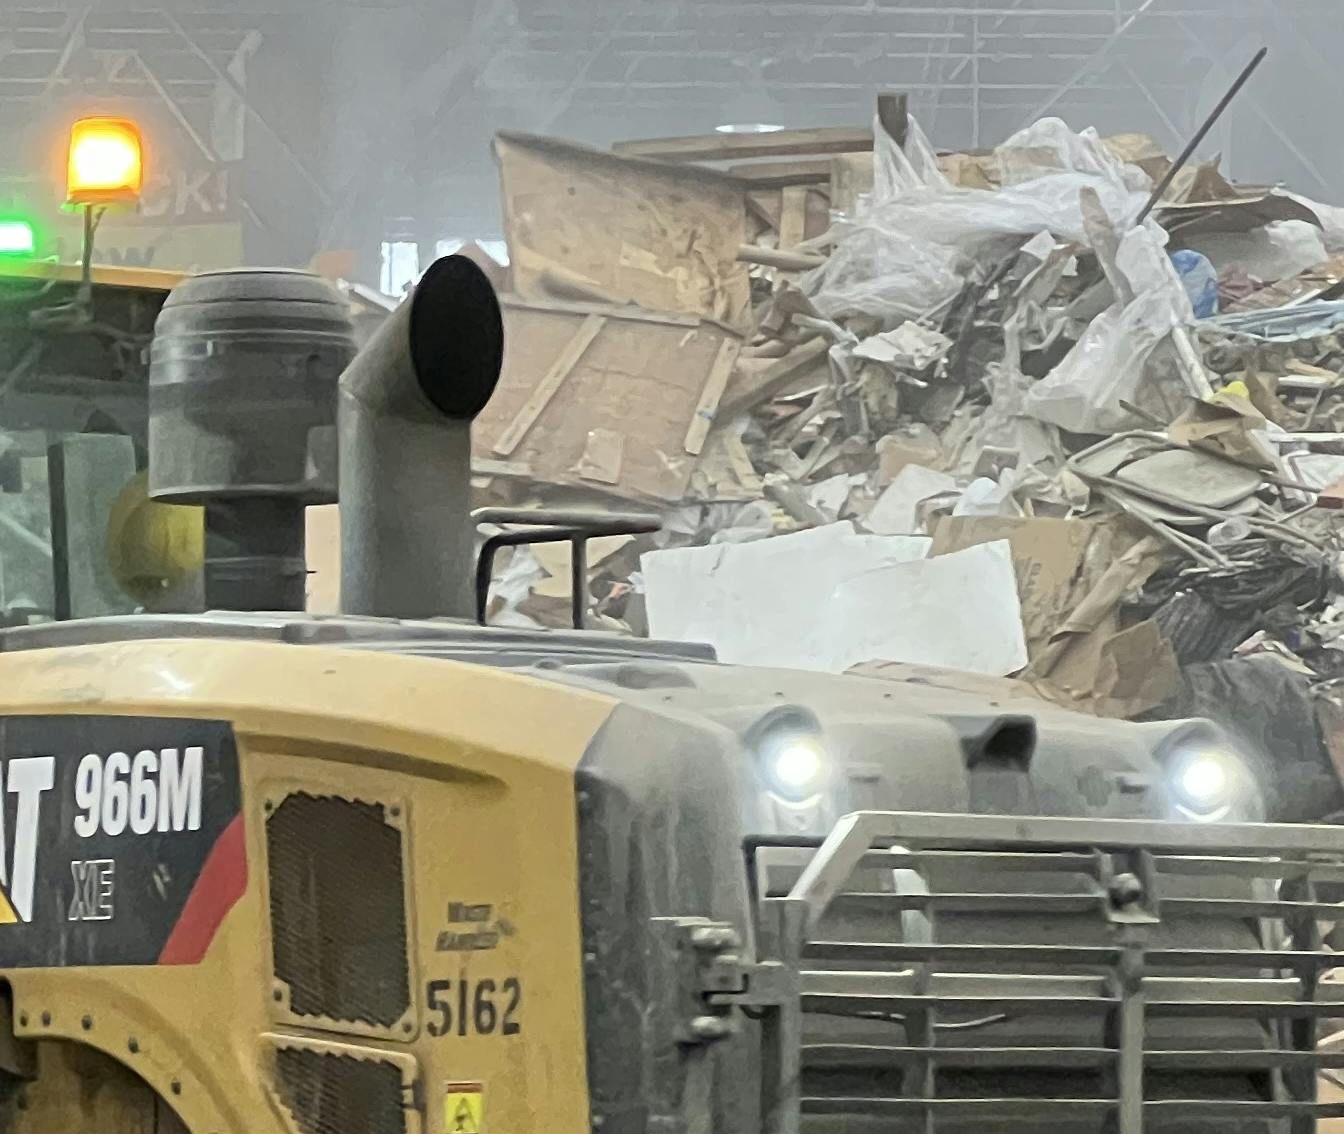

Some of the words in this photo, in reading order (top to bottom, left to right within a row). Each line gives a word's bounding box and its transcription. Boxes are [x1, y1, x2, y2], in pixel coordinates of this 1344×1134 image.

[73, 746, 205, 839] 966M
[68, 859, 116, 922] XE
[426, 977, 521, 1038] 5162
